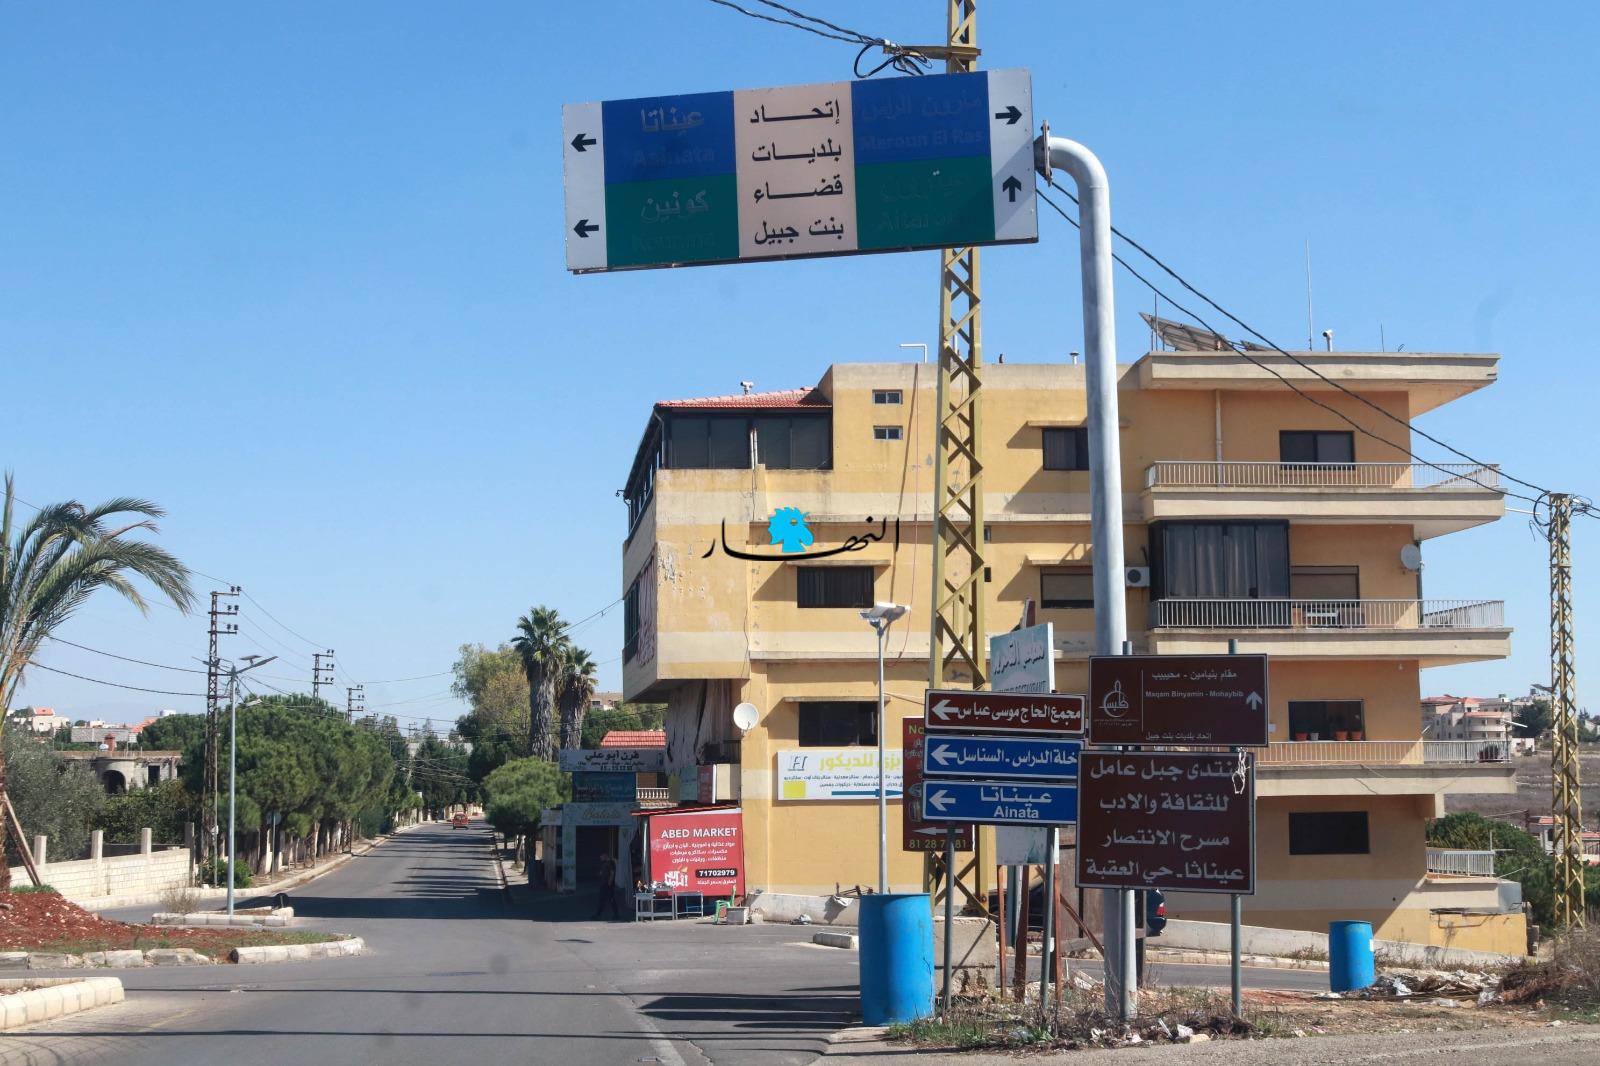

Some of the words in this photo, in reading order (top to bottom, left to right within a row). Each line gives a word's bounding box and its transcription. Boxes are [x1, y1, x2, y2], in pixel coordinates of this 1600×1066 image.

[640, 107, 704, 136] عيناتا
[750, 99, 839, 125] إتحاد
[752, 138, 841, 163] بلديات
[753, 174, 843, 203] قضاء
[754, 220, 799, 245] جبيل
[808, 217, 843, 240] بنت
[1145, 690, 1170, 699] Maqam
[1172, 690, 1204, 699] Binyamin
[958, 701, 990, 719] عباس
[1020, 703, 1050, 723] الحاج
[1050, 706, 1080, 725] مجمع
[1090, 758, 1137, 779] عامل
[1141, 759, 1184, 781] جبل
[1187, 760, 1236, 780] نتدى
[980, 786, 1052, 807] عيناتا
[1100, 793, 1158, 814] والادب
[1161, 792, 1229, 812] للثقافة
[993, 806, 1039, 819] Ainata
[661, 829, 690, 839] ABED
[693, 827, 738, 837] MARKET
[1101, 828, 1176, 847] الانتصار
[1180, 831, 1230, 851] مسرح
[1086, 858, 1139, 880] العقبة
[1142, 867, 1173, 884] حي
